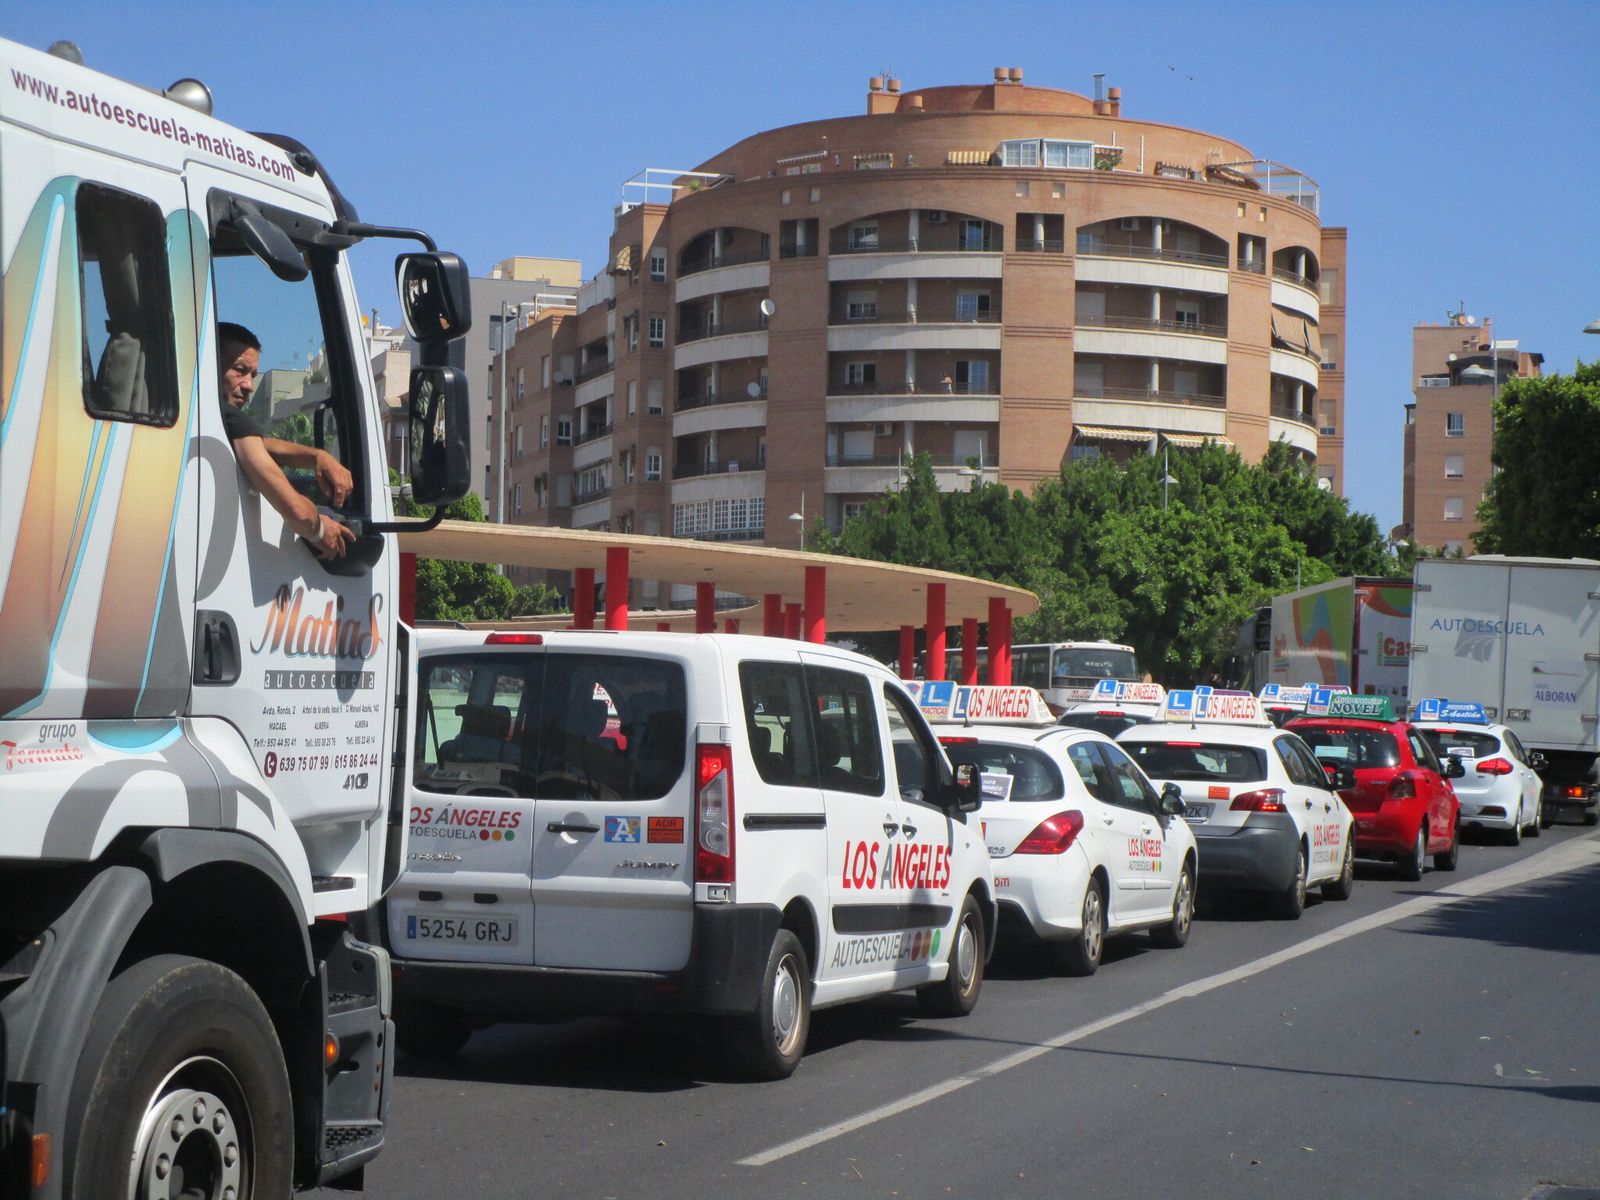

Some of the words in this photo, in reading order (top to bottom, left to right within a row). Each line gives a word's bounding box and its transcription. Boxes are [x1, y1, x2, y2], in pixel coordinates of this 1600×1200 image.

[11, 68, 296, 182] www.autoescuela-matias.com
[1430, 618, 1545, 636] AUTOESCUELA
[264, 672, 375, 688] autoescuela
[928, 685, 944, 702] L
[1173, 694, 1185, 707] L
[1315, 692, 1324, 703] L
[1535, 690, 1576, 703] ALBORAN
[985, 688, 1031, 718] ANGELES
[1221, 697, 1256, 719] ANGELES
[1331, 703, 1381, 715] NOVEL
[1425, 701, 1433, 711] L
[39, 723, 77, 743] grupo
[279, 757, 296, 772] 639
[298, 757, 307, 771] 75
[308, 756, 318, 770] 07
[320, 756, 329, 770] 99
[334, 754, 348, 769] 615
[349, 754, 358, 768] 86
[359, 753, 368, 767] 24
[656, 819, 676, 828] ADR
[1128, 837, 1139, 857] LOS
[843, 841, 879, 890] LOS
[420, 918, 467, 940] 5254
[475, 921, 512, 942] GRJ
[831, 934, 911, 969] AUTOESCUELA
